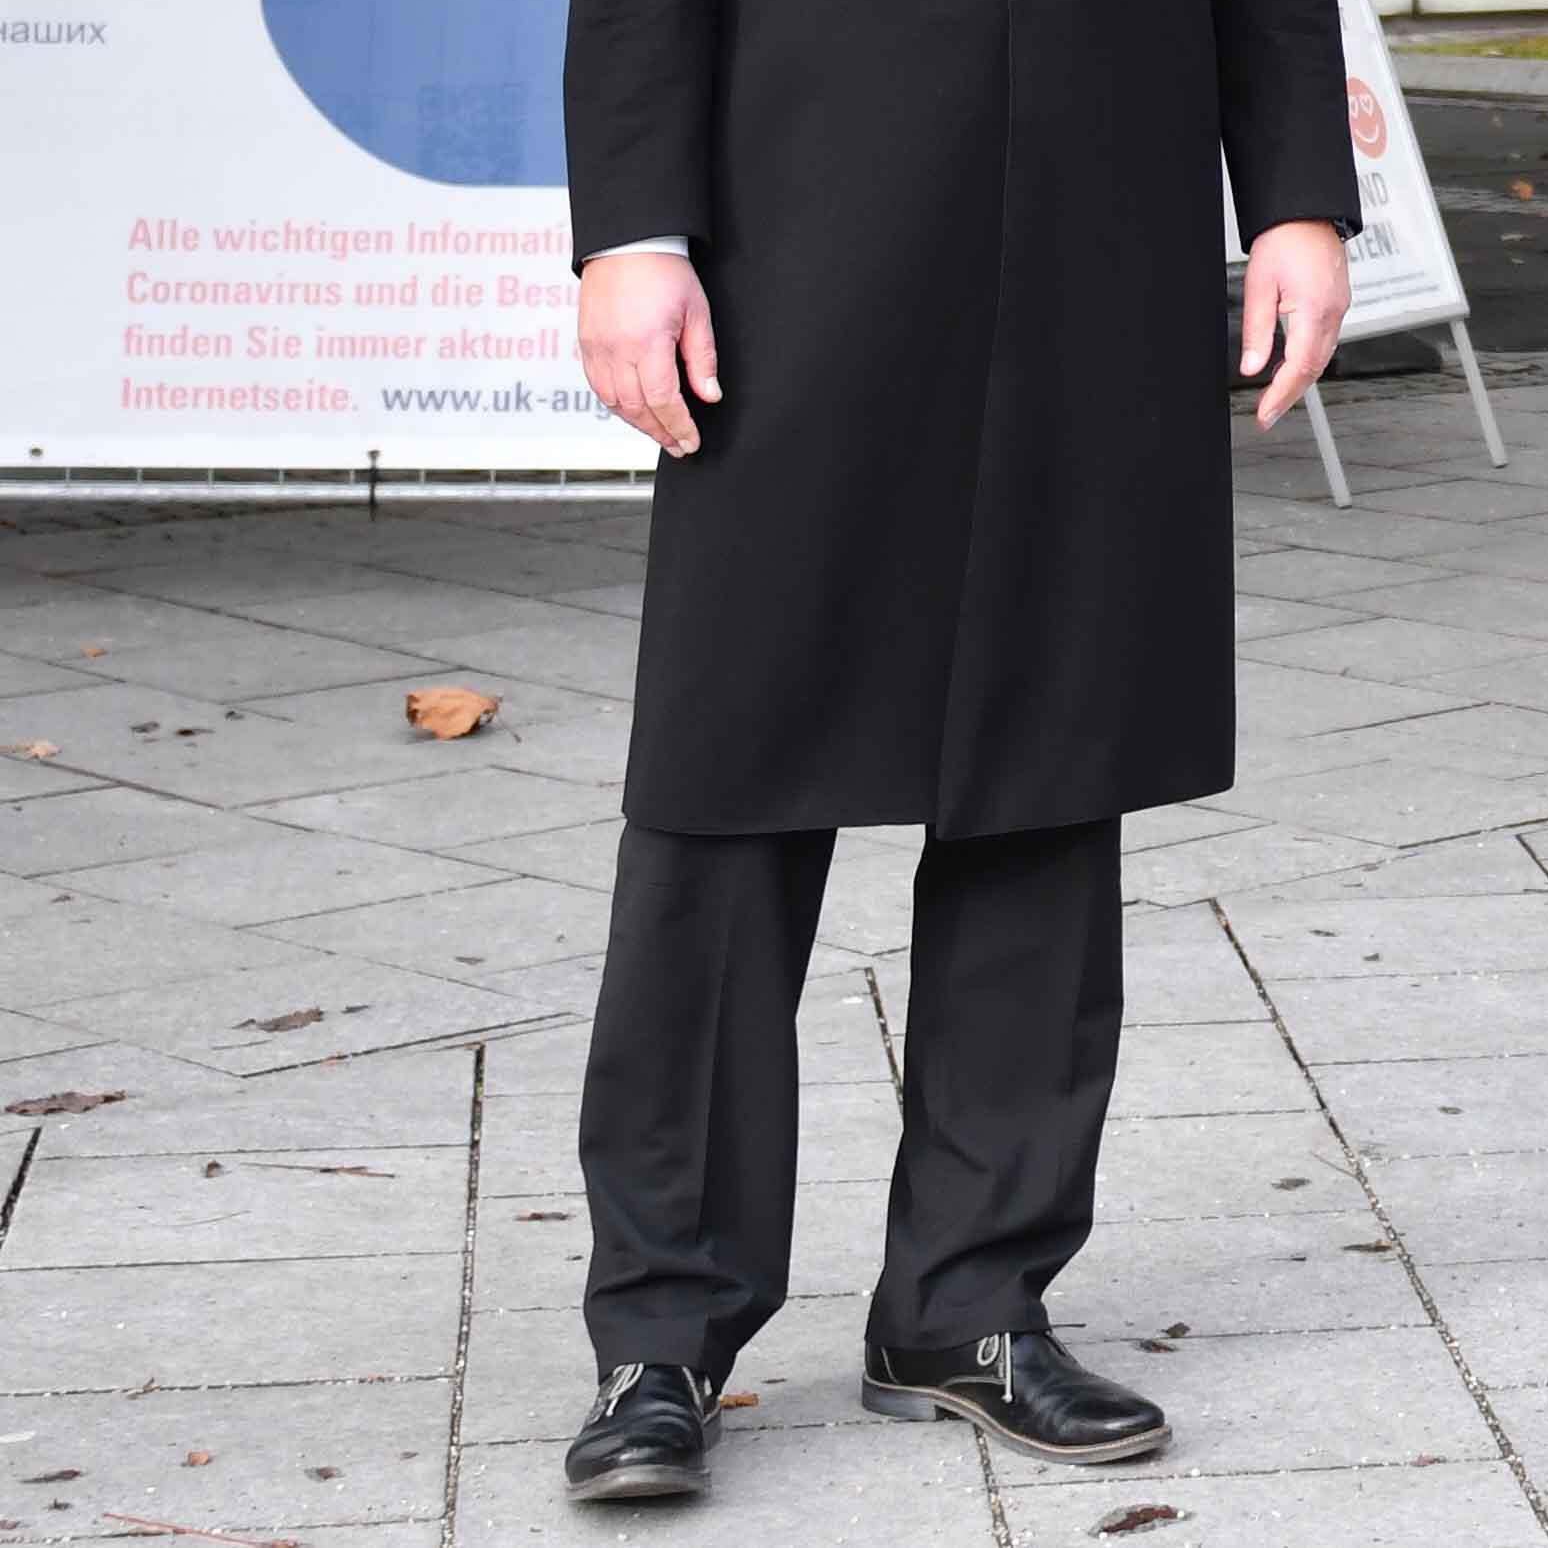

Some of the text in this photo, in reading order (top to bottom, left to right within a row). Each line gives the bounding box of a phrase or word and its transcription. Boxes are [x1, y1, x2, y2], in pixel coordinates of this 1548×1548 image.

[128, 217, 573, 262] Alle wichtigen Informati
[126, 270, 343, 306] Coronavirus
[354, 274, 418, 306] und
[431, 275, 484, 307] die
[123, 323, 233, 358] finden
[246, 324, 303, 359] Sie
[315, 325, 427, 360] immer
[438, 328, 560, 361] aktuell
[121, 376, 359, 412] Internetseite.
